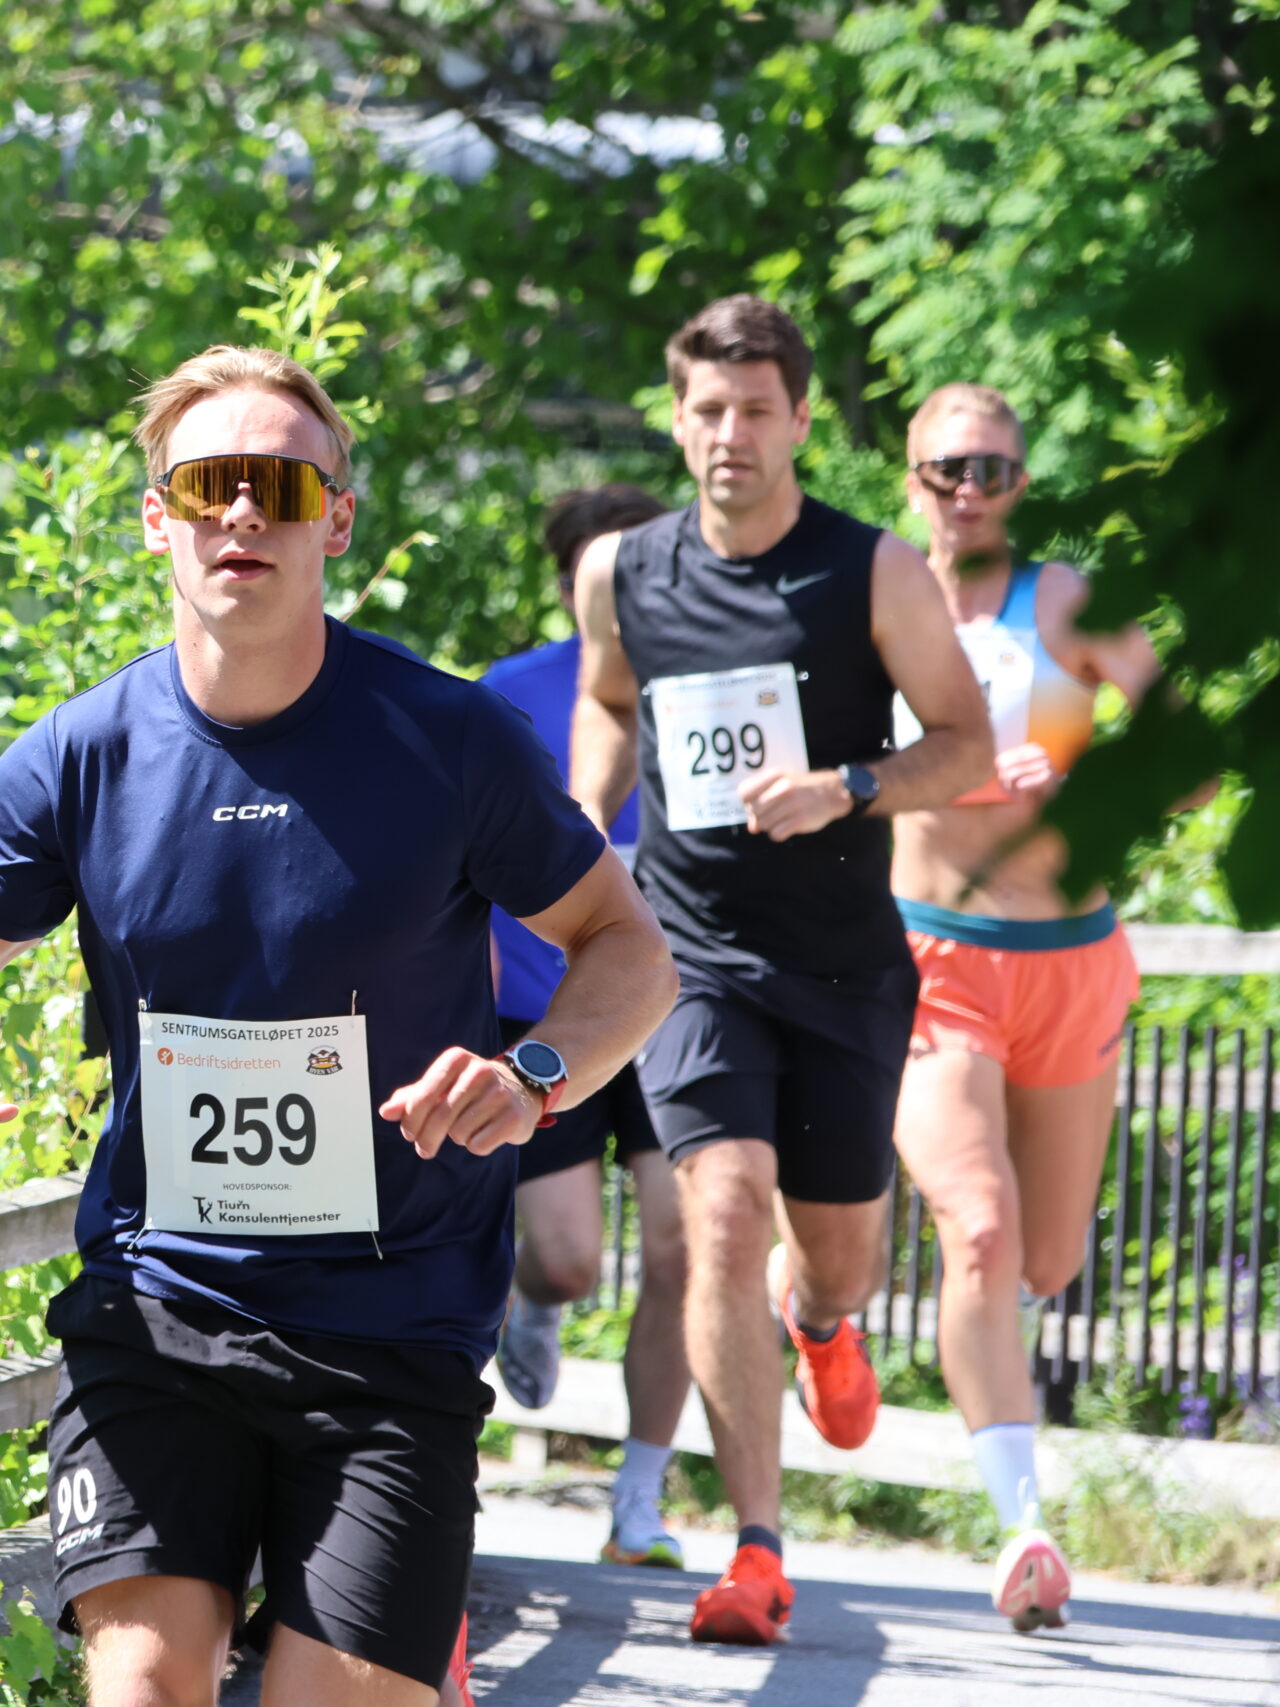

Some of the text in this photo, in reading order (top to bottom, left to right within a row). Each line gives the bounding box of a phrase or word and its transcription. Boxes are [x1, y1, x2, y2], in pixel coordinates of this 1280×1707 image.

[687, 723, 766, 776] 299
[212, 803, 288, 821] CCM
[161, 1022, 339, 1041] SENTRUMSGATELØPET 2025
[177, 1054, 281, 1070] Bedriftsidretten
[189, 1093, 317, 1166] 259
[222, 1183, 292, 1191] HOVEDSPONSOR:
[219, 1212, 341, 1226] Konsulenttjenester
[57, 1467, 98, 1536] 90
[56, 1523, 105, 1557] CCM
